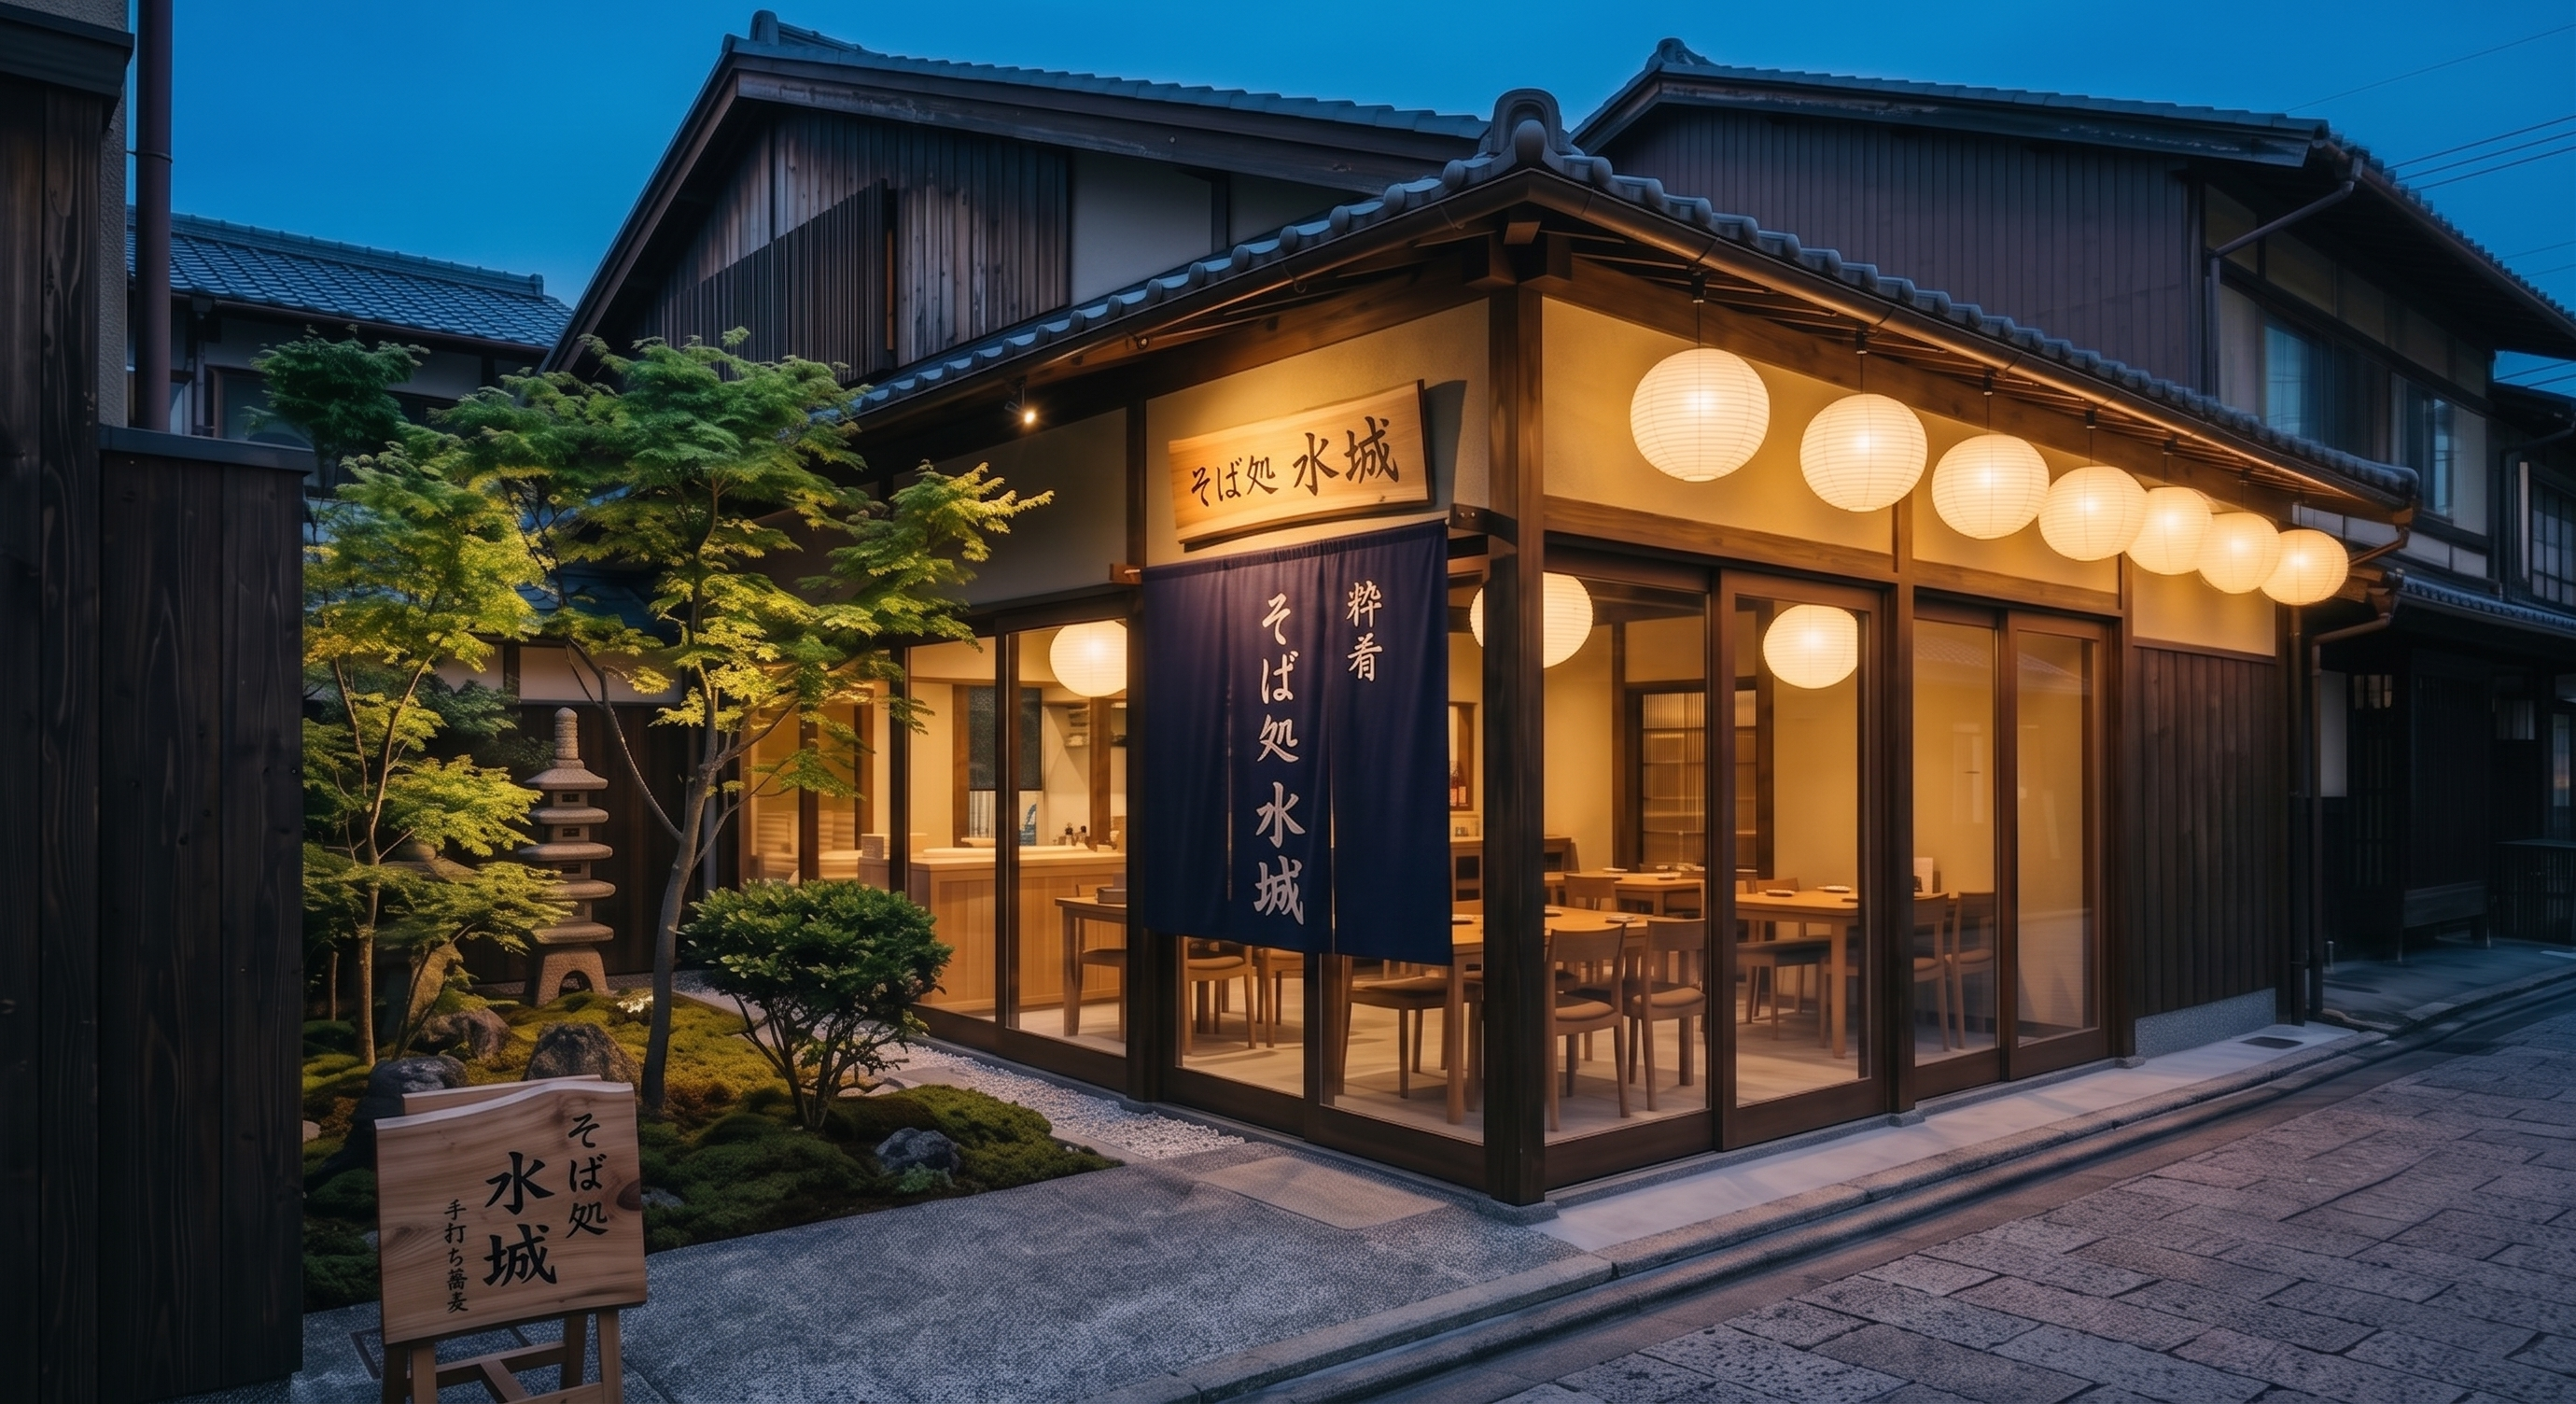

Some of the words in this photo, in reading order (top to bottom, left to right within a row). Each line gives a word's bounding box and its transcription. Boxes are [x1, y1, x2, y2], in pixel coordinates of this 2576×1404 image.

[483, 1151, 557, 1287] 水城
[566, 1113, 609, 1239] そば処
